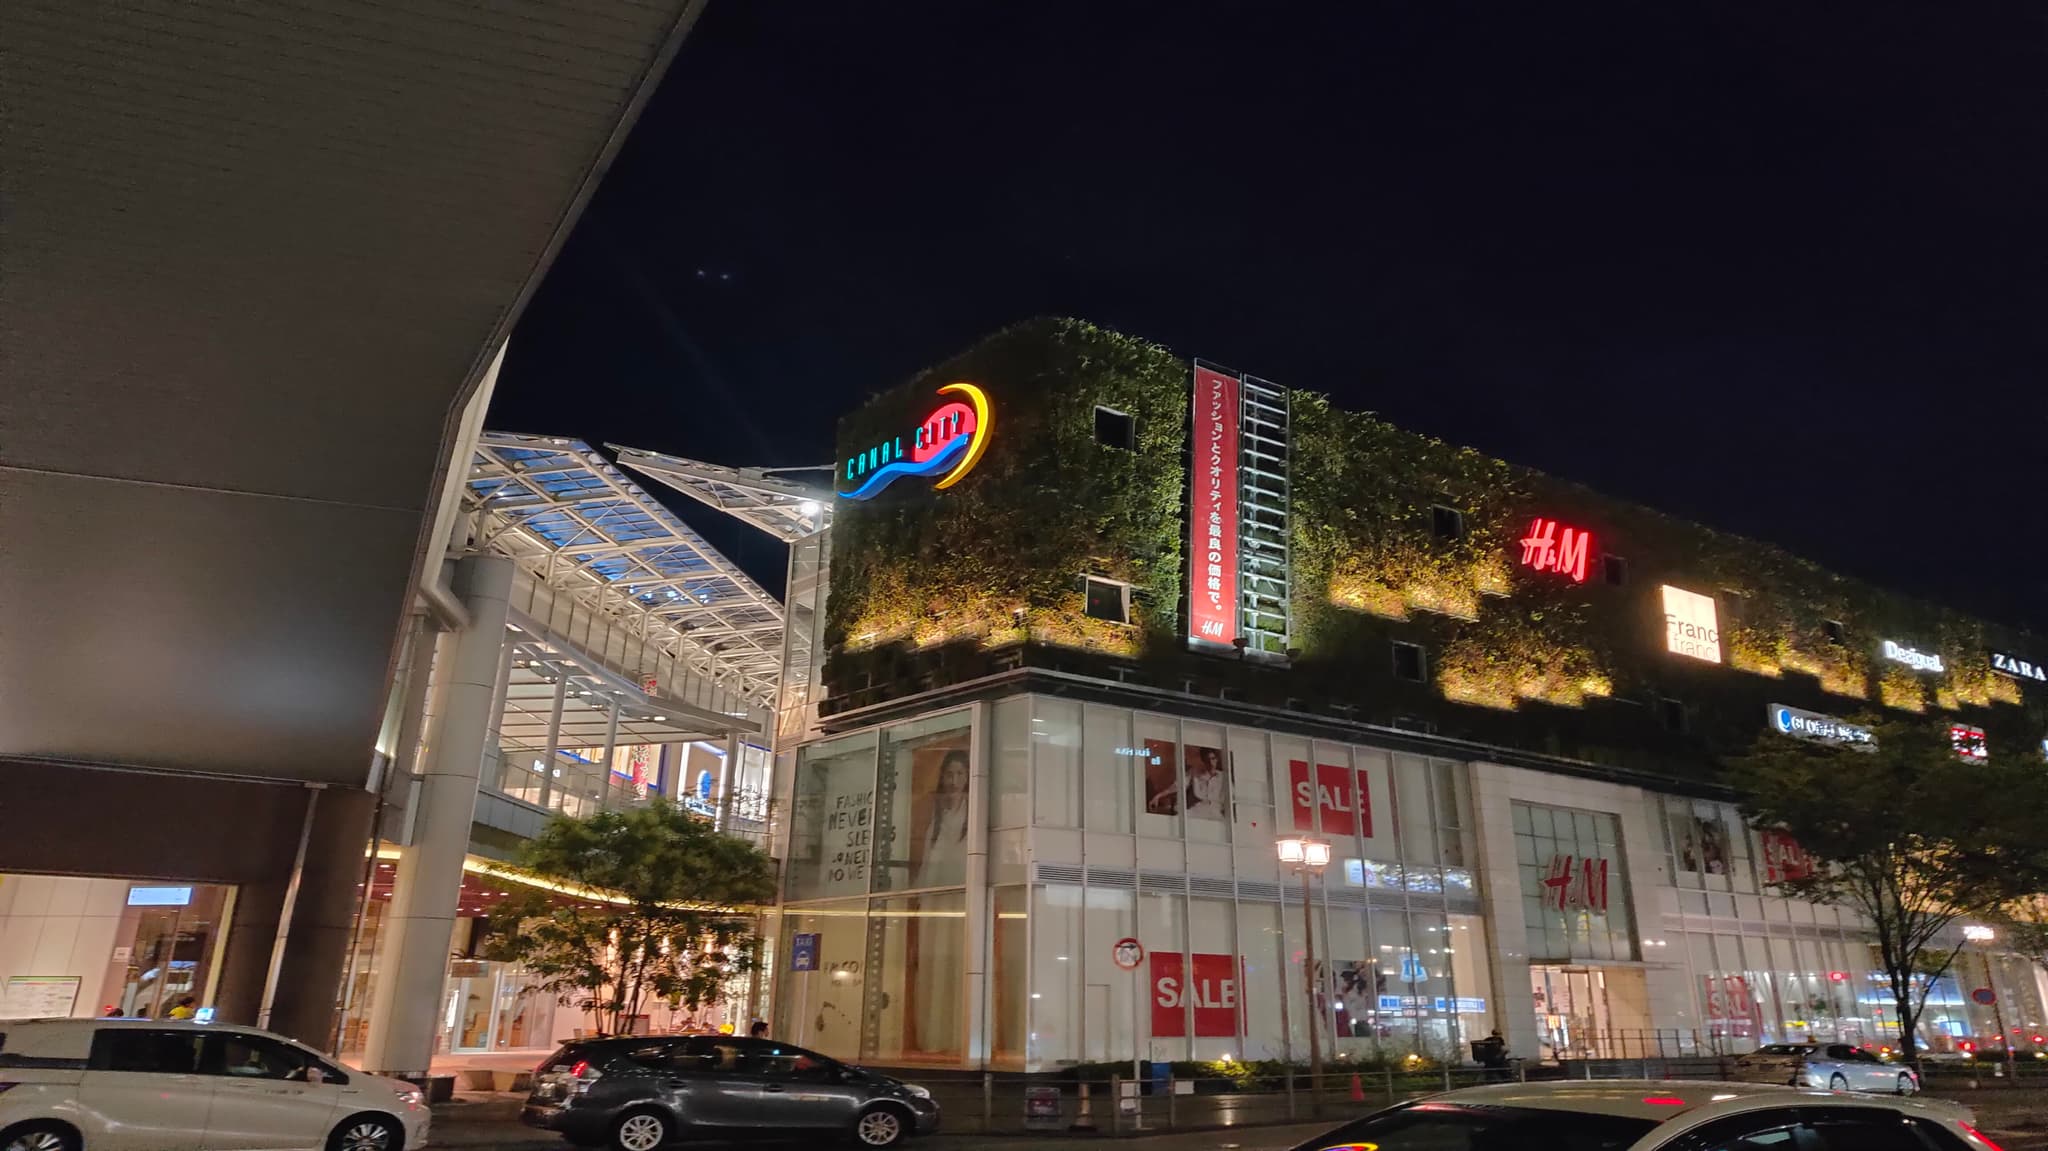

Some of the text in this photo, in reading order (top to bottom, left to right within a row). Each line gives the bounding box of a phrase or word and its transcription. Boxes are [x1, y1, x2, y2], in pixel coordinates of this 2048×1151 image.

[847, 410, 960, 480] CANAL CITY
[1520, 518, 1589, 582] H&M
[1201, 620, 1224, 637] H&M
[1665, 612, 1720, 643] Franc
[1993, 653, 2047, 682] ZARA
[1541, 853, 1608, 914] H&M
[1157, 977, 1237, 1009] SALE
[1711, 993, 1749, 1016] SAL
